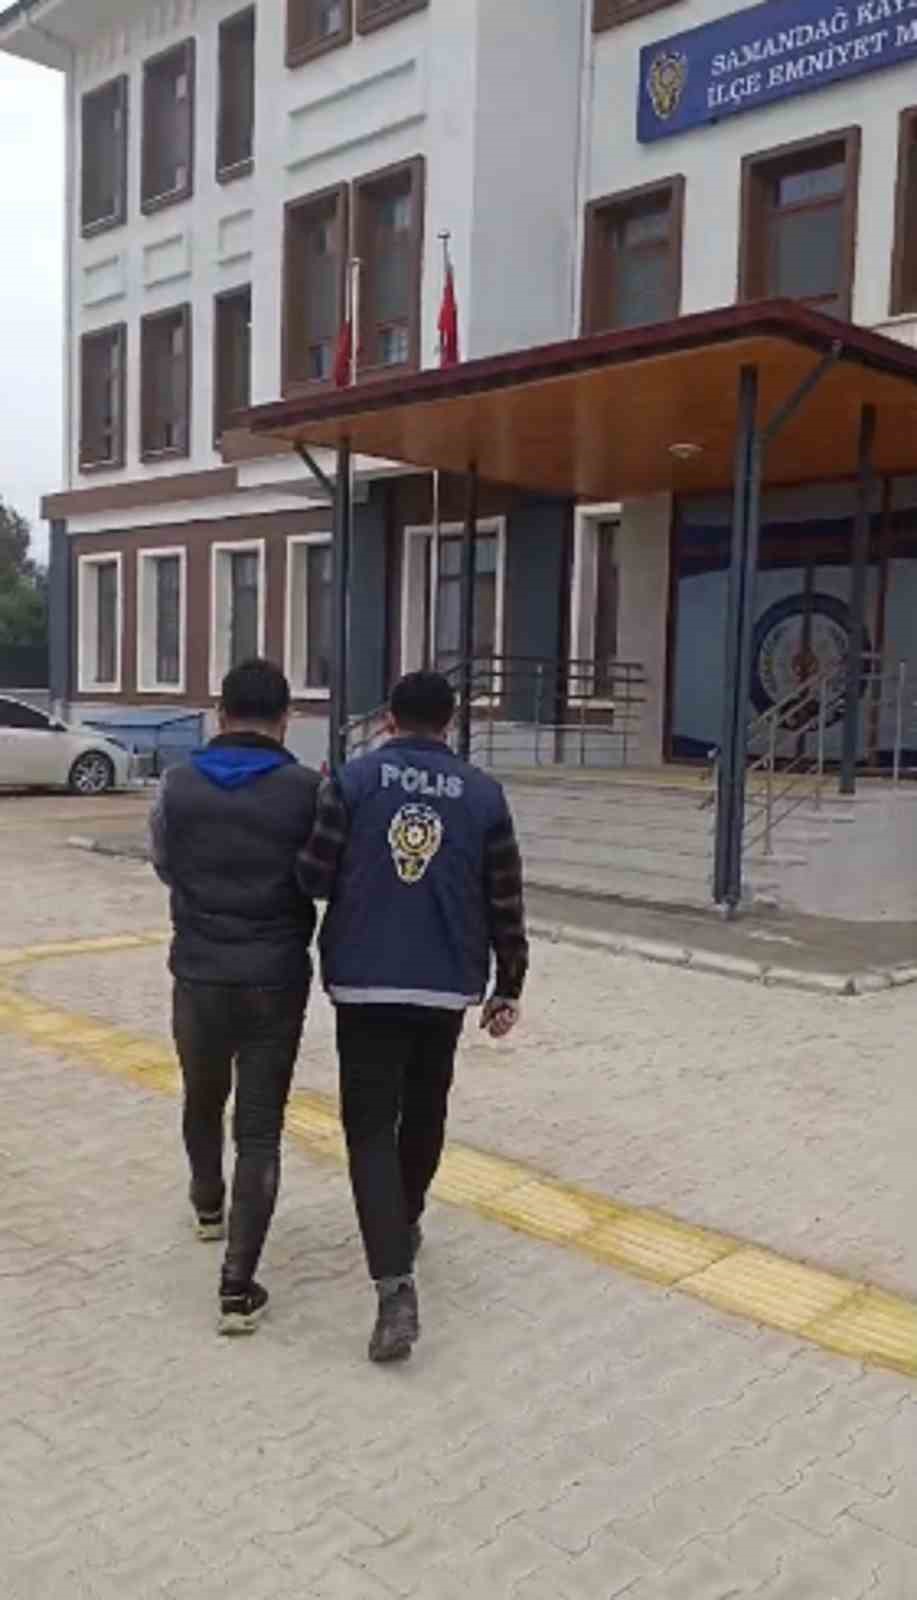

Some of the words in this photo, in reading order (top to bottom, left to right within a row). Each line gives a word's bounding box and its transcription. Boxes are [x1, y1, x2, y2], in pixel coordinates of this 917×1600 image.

[707, 71, 762, 109] İLÇE
[767, 31, 889, 89] EMNİYET
[711, 7, 849, 76] SAMANDAĞ
